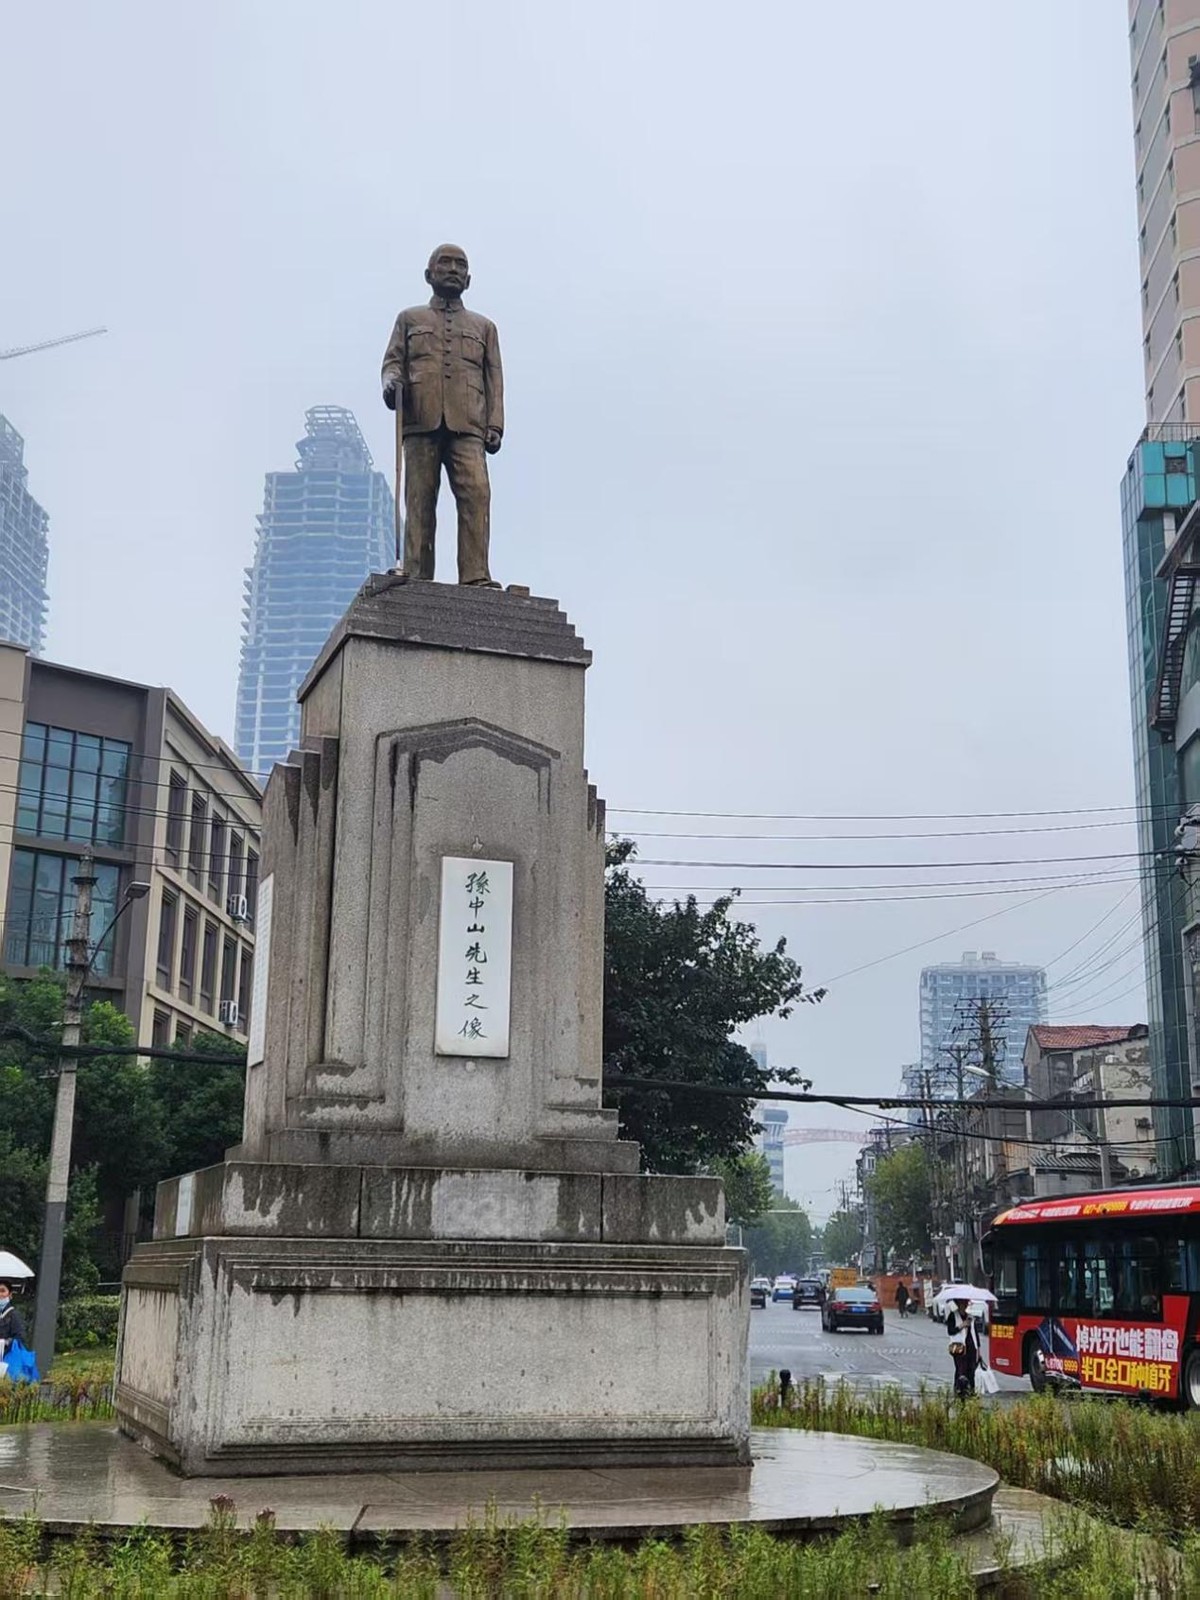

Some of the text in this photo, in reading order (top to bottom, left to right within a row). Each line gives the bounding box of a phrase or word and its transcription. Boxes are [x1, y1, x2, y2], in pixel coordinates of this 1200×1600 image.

[458, 871, 490, 1039] 孫中山先生之像
[1076, 1324, 1179, 1362] 掉光牙也能翻盘
[1081, 1356, 1172, 1392] 半口全口种植牙
